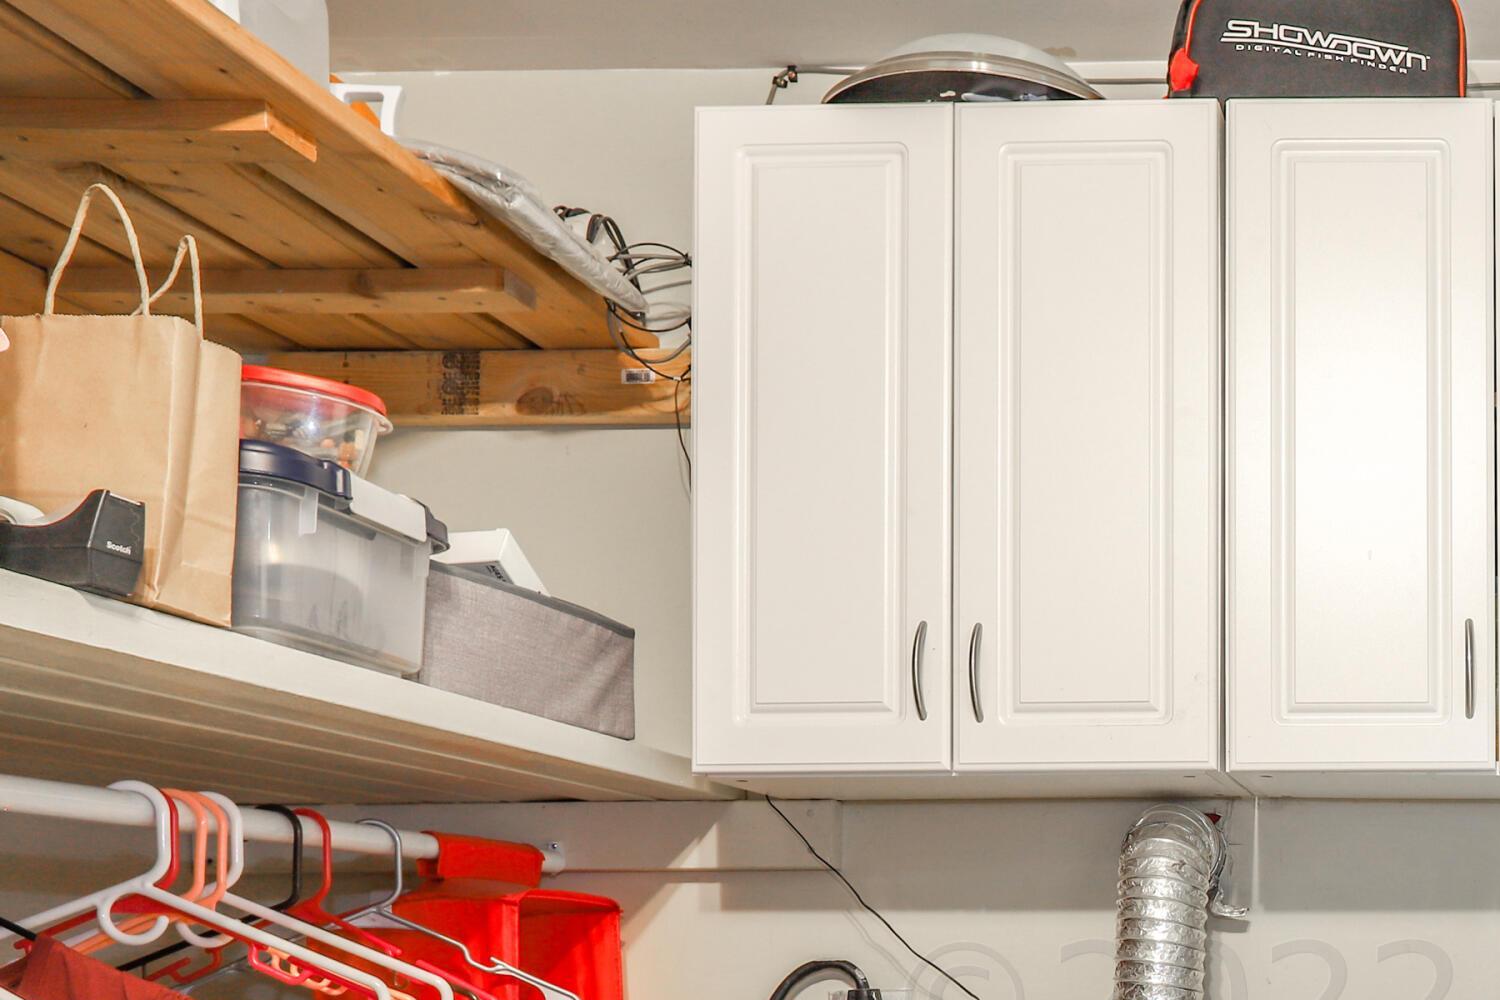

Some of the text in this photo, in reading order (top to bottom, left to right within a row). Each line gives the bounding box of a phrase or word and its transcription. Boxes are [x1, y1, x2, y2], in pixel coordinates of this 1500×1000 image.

[1221, 19, 1428, 71] SHOWDOWN
[1235, 44, 1408, 74] DIGITAL FISH FINDER
[106, 540, 132, 556] Scotch
